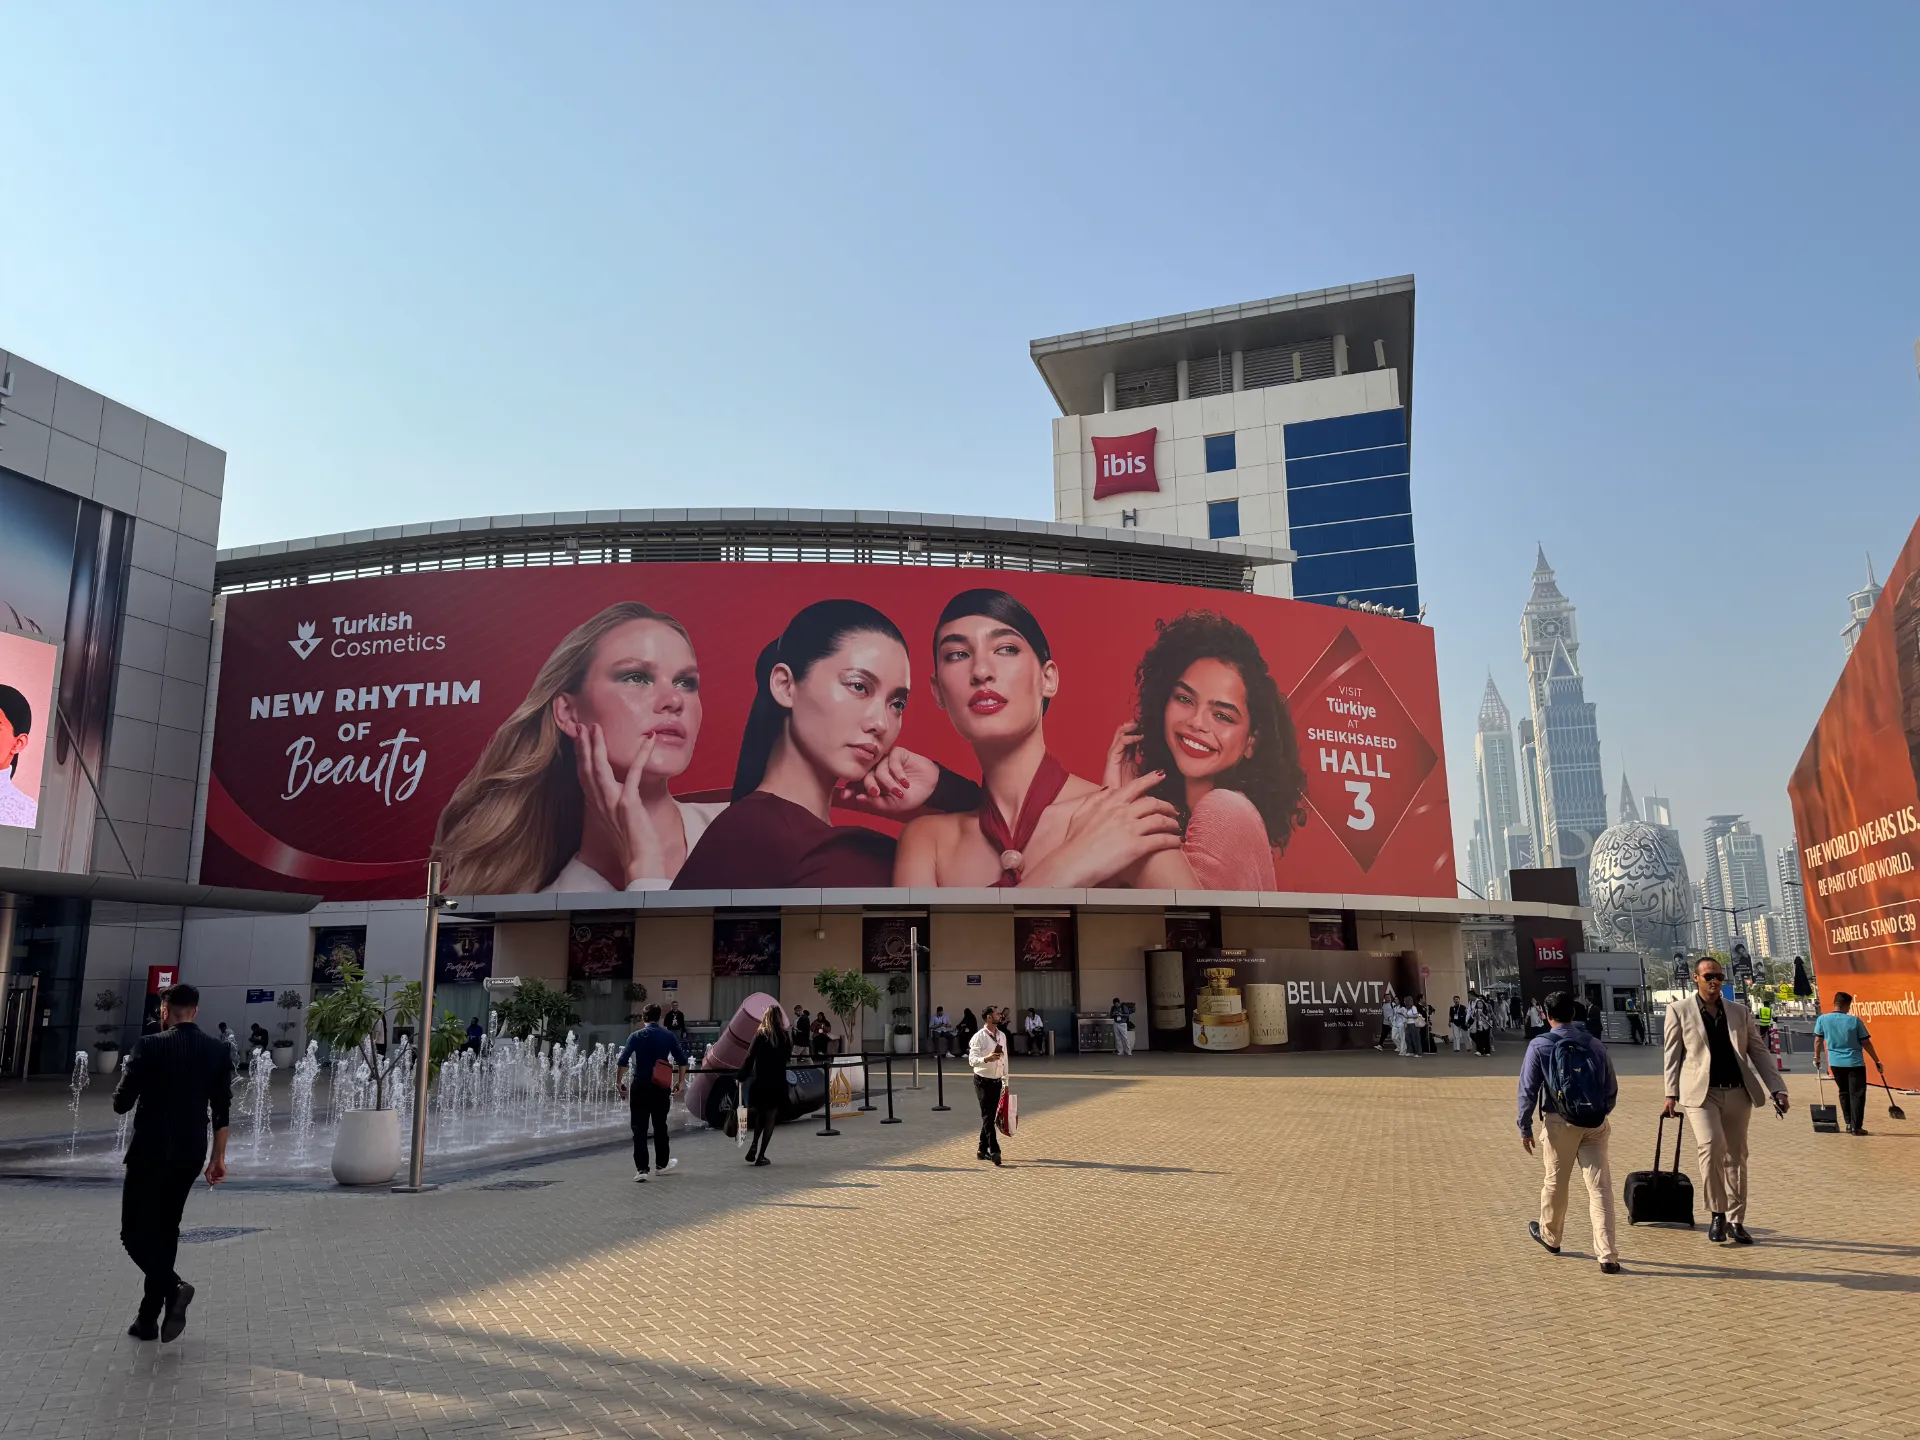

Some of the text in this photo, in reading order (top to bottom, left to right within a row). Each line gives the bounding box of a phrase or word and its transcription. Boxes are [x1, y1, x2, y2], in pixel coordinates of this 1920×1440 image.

[1102, 452, 1147, 478] ibis
[332, 611, 413, 636] Turkish
[331, 632, 446, 659] Cosmetics
[250, 679, 481, 720] NEW RHYTHM
[1338, 684, 1362, 698] VISIT
[1326, 696, 1377, 721] Türkiye
[338, 721, 371, 743] OF
[1347, 719, 1359, 729] AT
[1307, 728, 1398, 750] SHEIKHSAEED
[281, 728, 427, 807] Beauty
[1319, 749, 1391, 779] HALL
[1344, 781, 1376, 831] 3
[1804, 805, 1920, 869] THE WORLD WEARS US.
[1818, 852, 1915, 897] BE PART OF OUR WORLD.
[1831, 913, 1917, 945] ZA'ABEEL 6 STAND C39
[1538, 946, 1564, 960] ibis
[1287, 981, 1397, 1004] BELLAVITA
